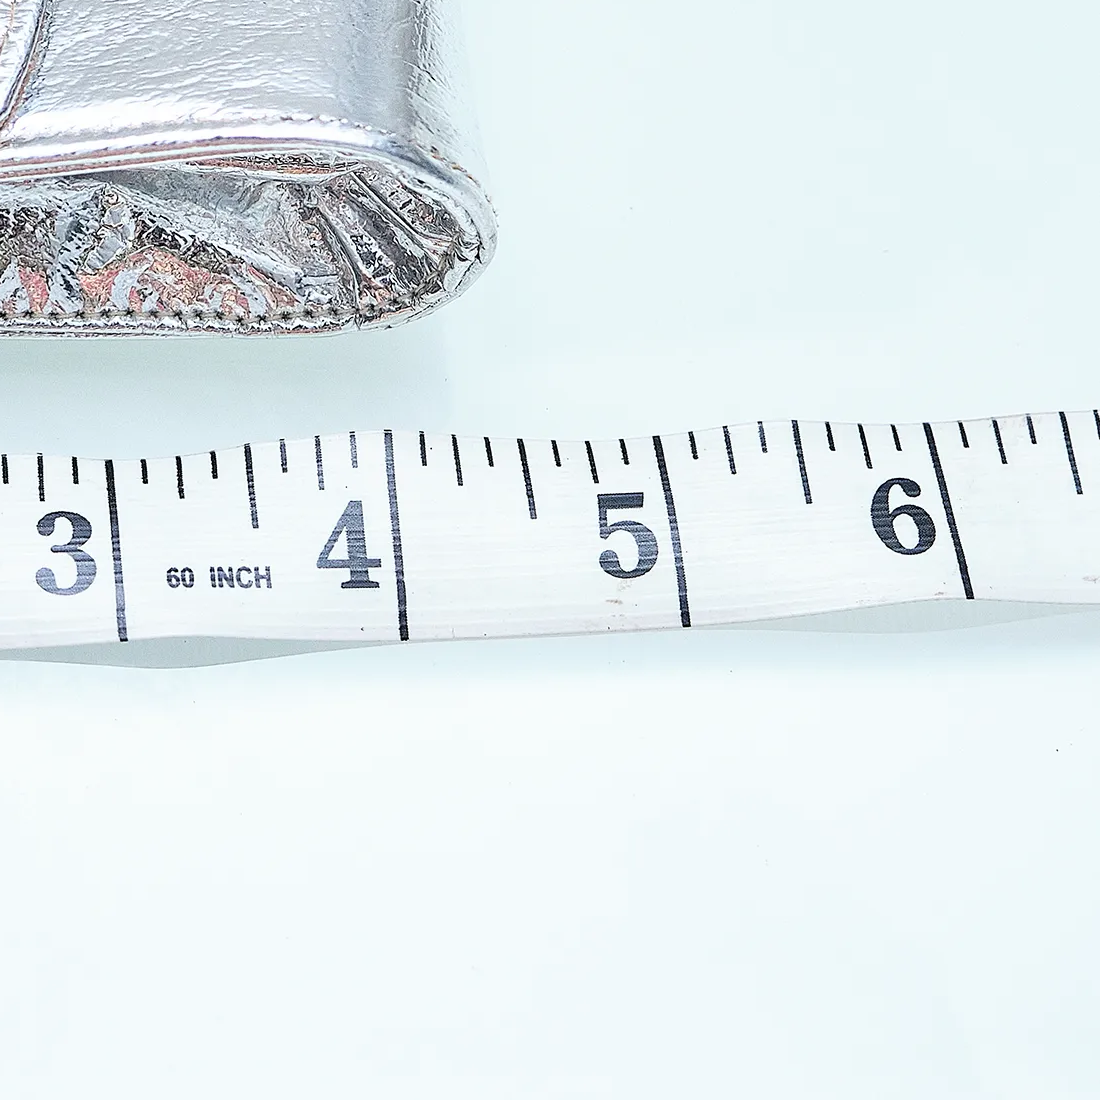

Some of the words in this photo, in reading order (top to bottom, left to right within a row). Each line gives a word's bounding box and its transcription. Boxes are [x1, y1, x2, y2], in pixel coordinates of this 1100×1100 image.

[34, 510, 98, 597] 3
[316, 499, 382, 590] 4
[596, 491, 659, 580] 5
[869, 477, 937, 556] 6
[166, 566, 195, 590] 60
[209, 565, 273, 590] INCH
